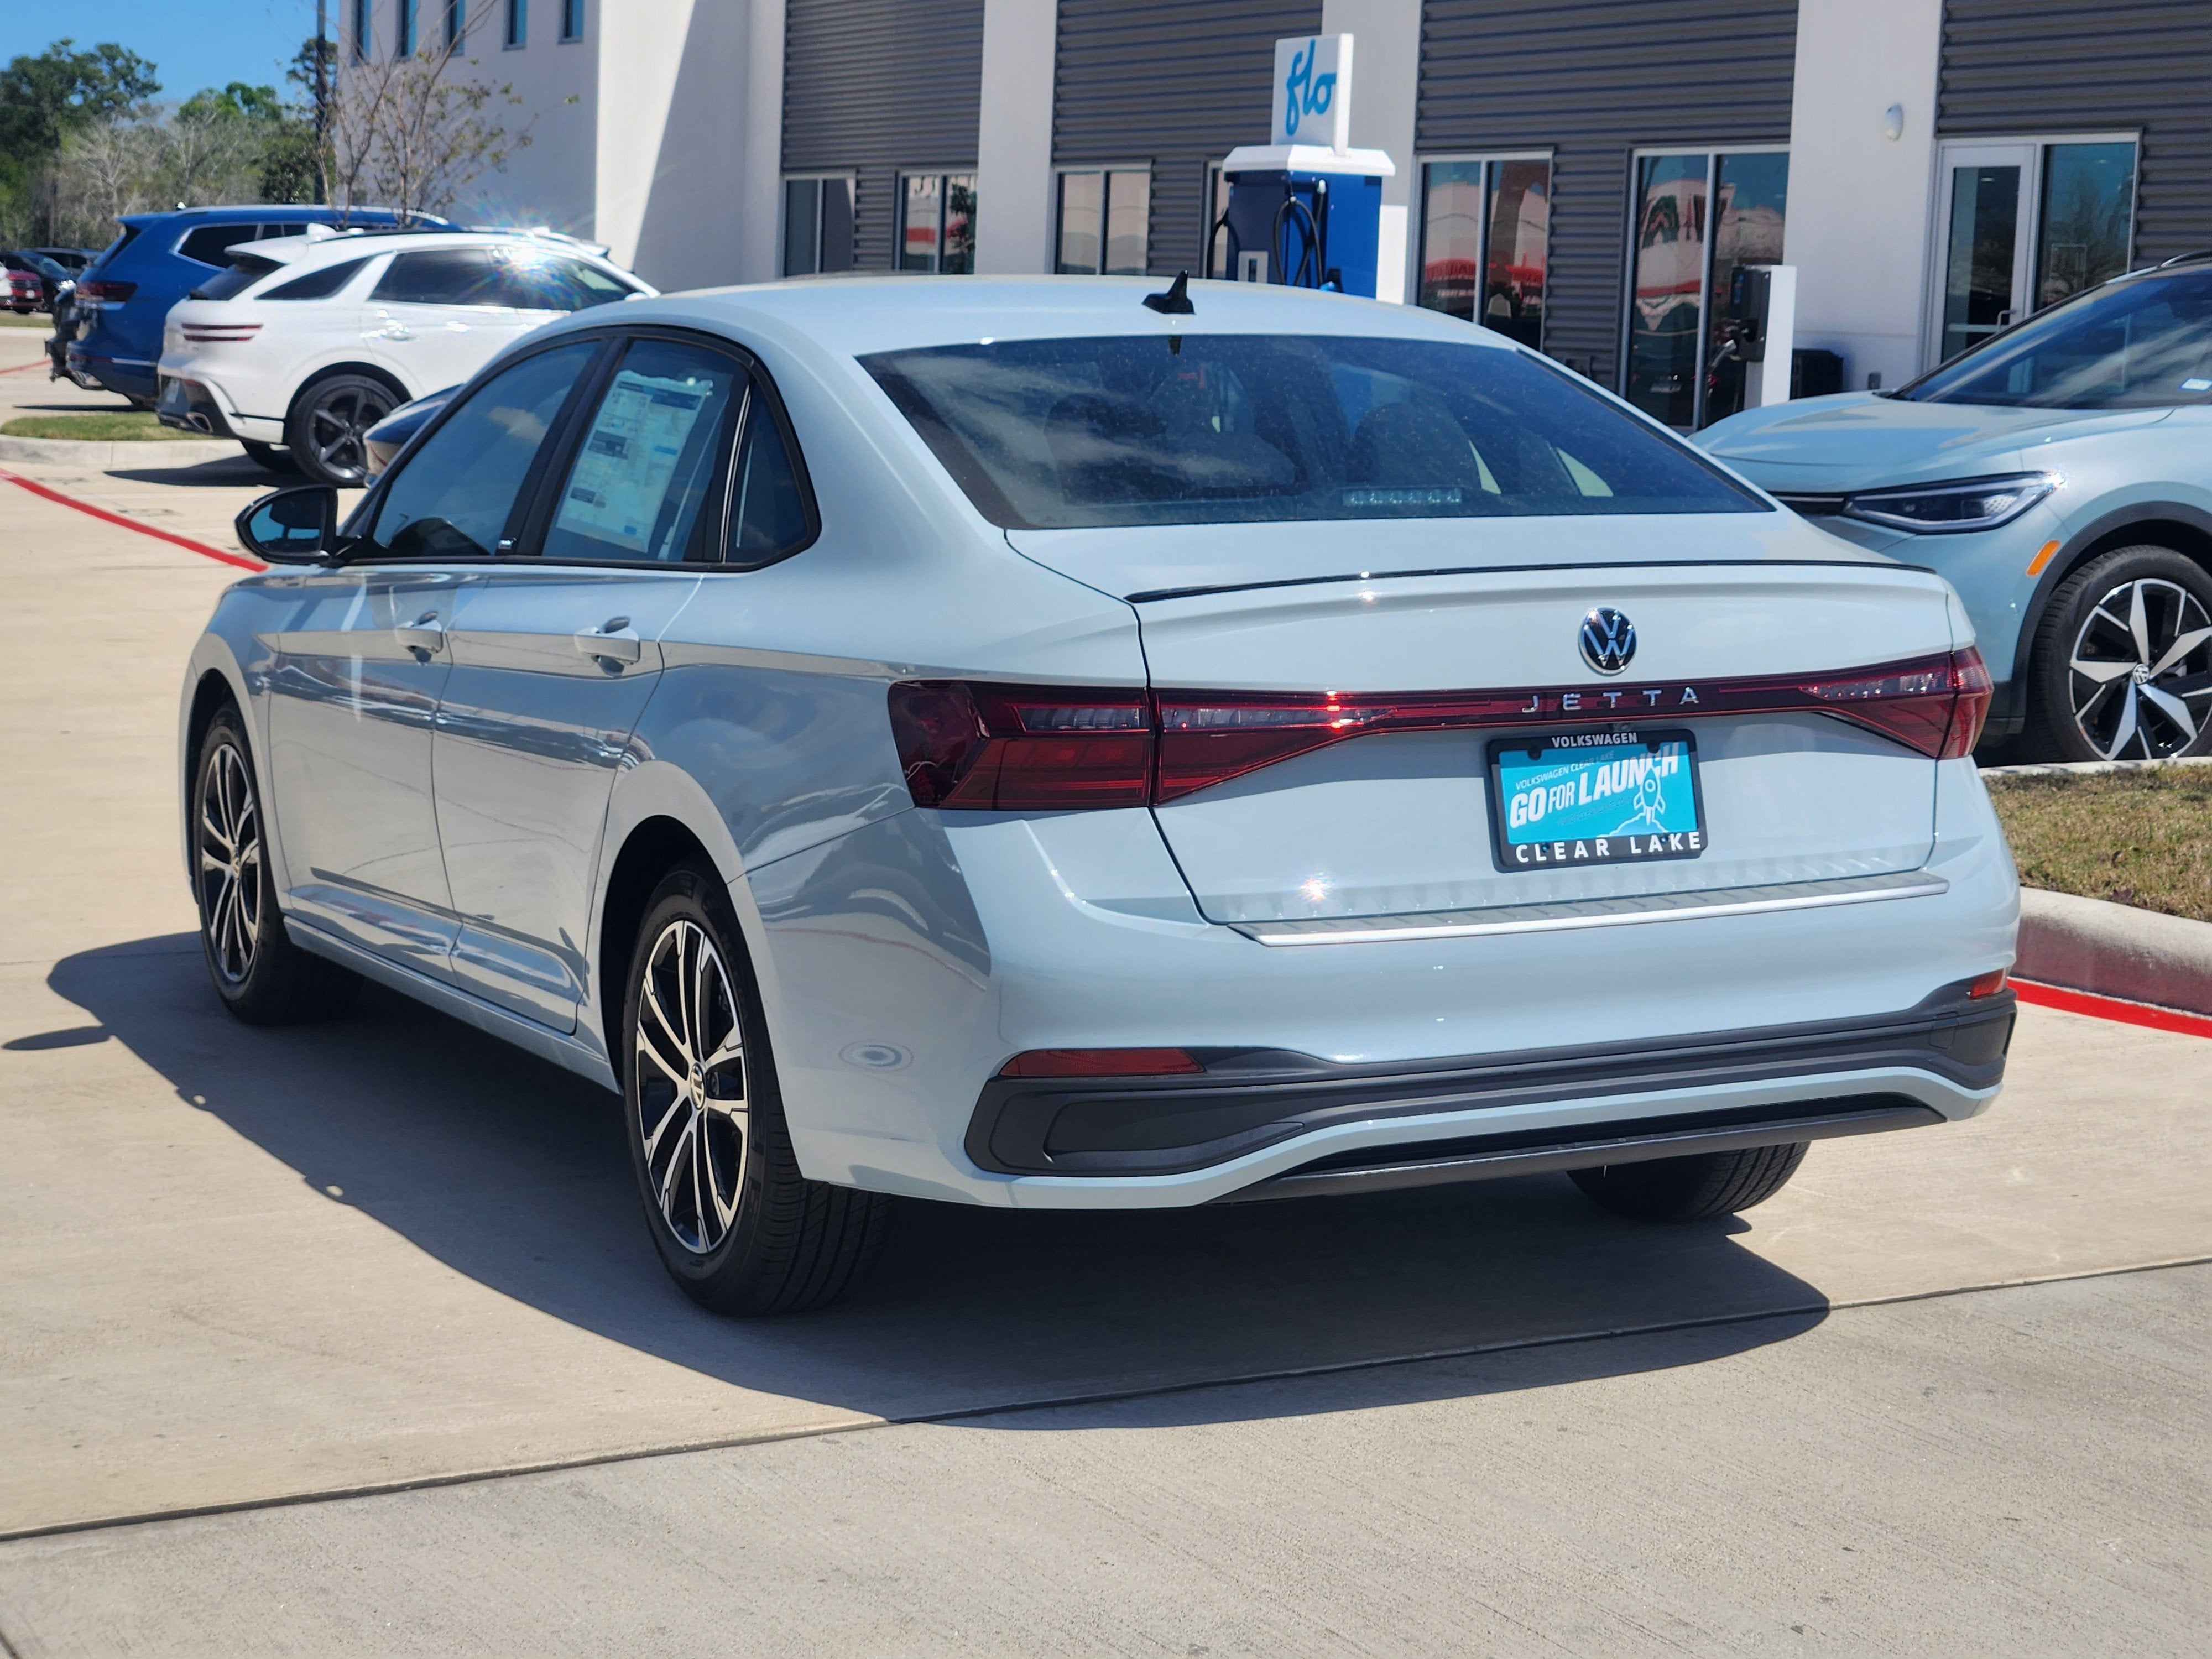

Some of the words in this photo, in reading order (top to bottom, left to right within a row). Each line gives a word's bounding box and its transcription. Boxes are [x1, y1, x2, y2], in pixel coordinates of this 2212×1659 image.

[1286, 38, 1337, 136] flo
[1521, 686, 1699, 713] JETTA
[1551, 732, 1637, 748] VOLKSWAGEN
[1515, 766, 1569, 790] VOLKSWAGEN
[1510, 787, 1547, 828] GO
[1548, 781, 1575, 813] FOR
[1516, 839, 1610, 863] CLEAR
[1630, 832, 1701, 855] LAKE
